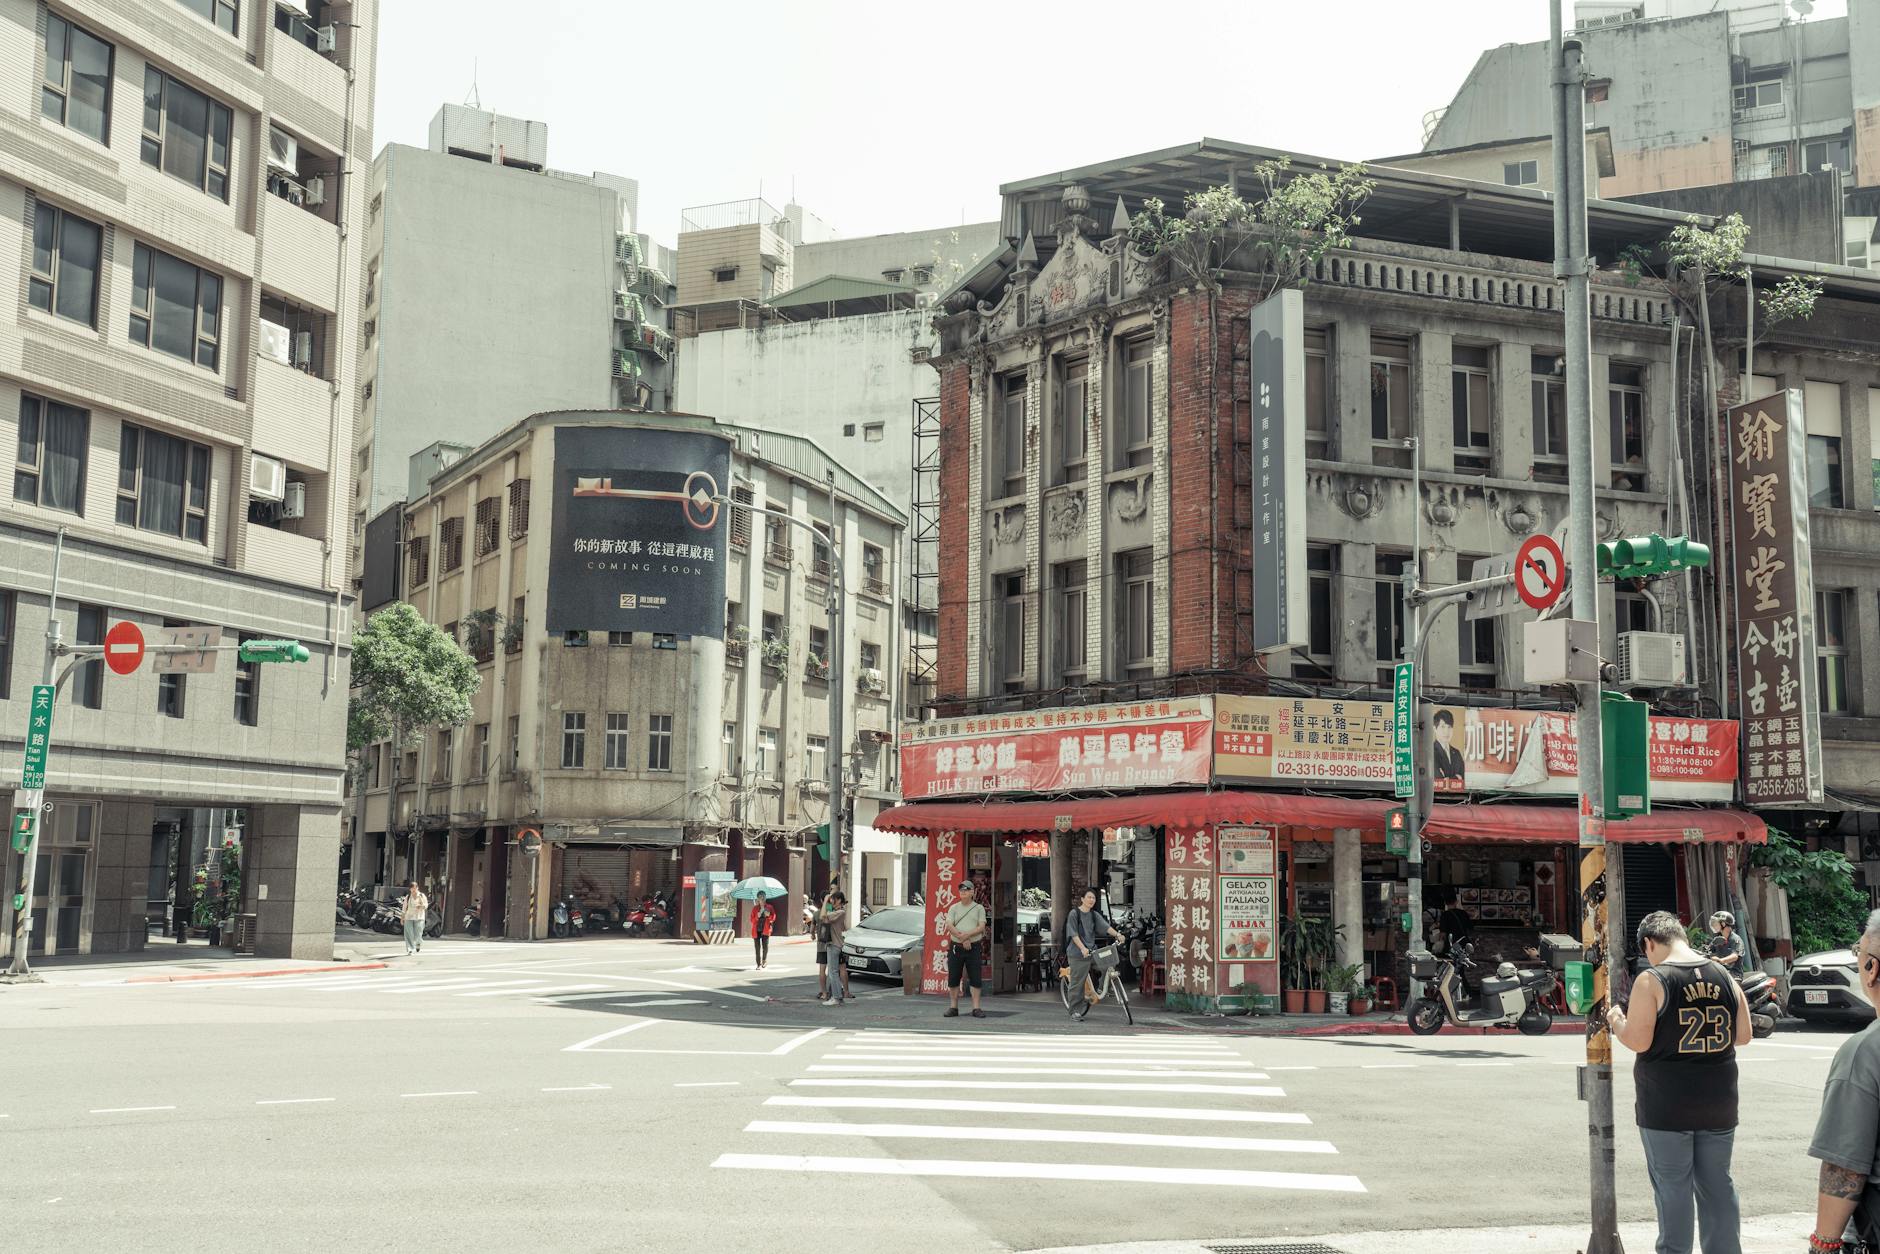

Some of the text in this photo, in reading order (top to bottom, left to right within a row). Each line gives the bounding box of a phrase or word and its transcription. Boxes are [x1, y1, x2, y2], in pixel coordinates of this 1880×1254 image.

[1736, 410, 1785, 611] 翰寶堂
[573, 538, 642, 555] 你的新故事
[587, 562, 701, 575] COMING SOON
[32, 697, 49, 746] 天水路
[917, 723, 960, 738] 永慶房屋
[966, 717, 1036, 733] 先誠實再成交
[1043, 709, 1109, 727] 堅持不炒房
[1116, 703, 1170, 720] 不賺差價
[1231, 713, 1270, 725] 永慶房屋
[1278, 708, 1290, 735] 經營
[1397, 679, 1408, 743] 長安西路
[1748, 720, 1764, 748] 水晶
[1785, 717, 1801, 745] 玉器
[936, 742, 1017, 774] 好客炒飯
[1278, 750, 1311, 759] 以上路段
[1670, 744, 1695, 755] Fried
[1698, 746, 1720, 756] Rice
[1689, 758, 1713, 767] 08:00
[1768, 750, 1784, 777] 木雕
[1786, 749, 1802, 776] 瓷器
[927, 775, 1025, 794] HULK Fried Rice
[1091, 767, 1120, 782] Wen
[1125, 765, 1175, 781] Brunch
[1757, 777, 1805, 797] 2556-2613
[1226, 881, 1267, 889] GELATO
[1225, 896, 1270, 904] ITALIANO
[1169, 875, 1188, 988] 蔬菜蛋餅
[1191, 876, 1213, 993] 鍋貼飲料
[1683, 982, 1721, 1002] JAMES
[1678, 1005, 1732, 1053] 23
